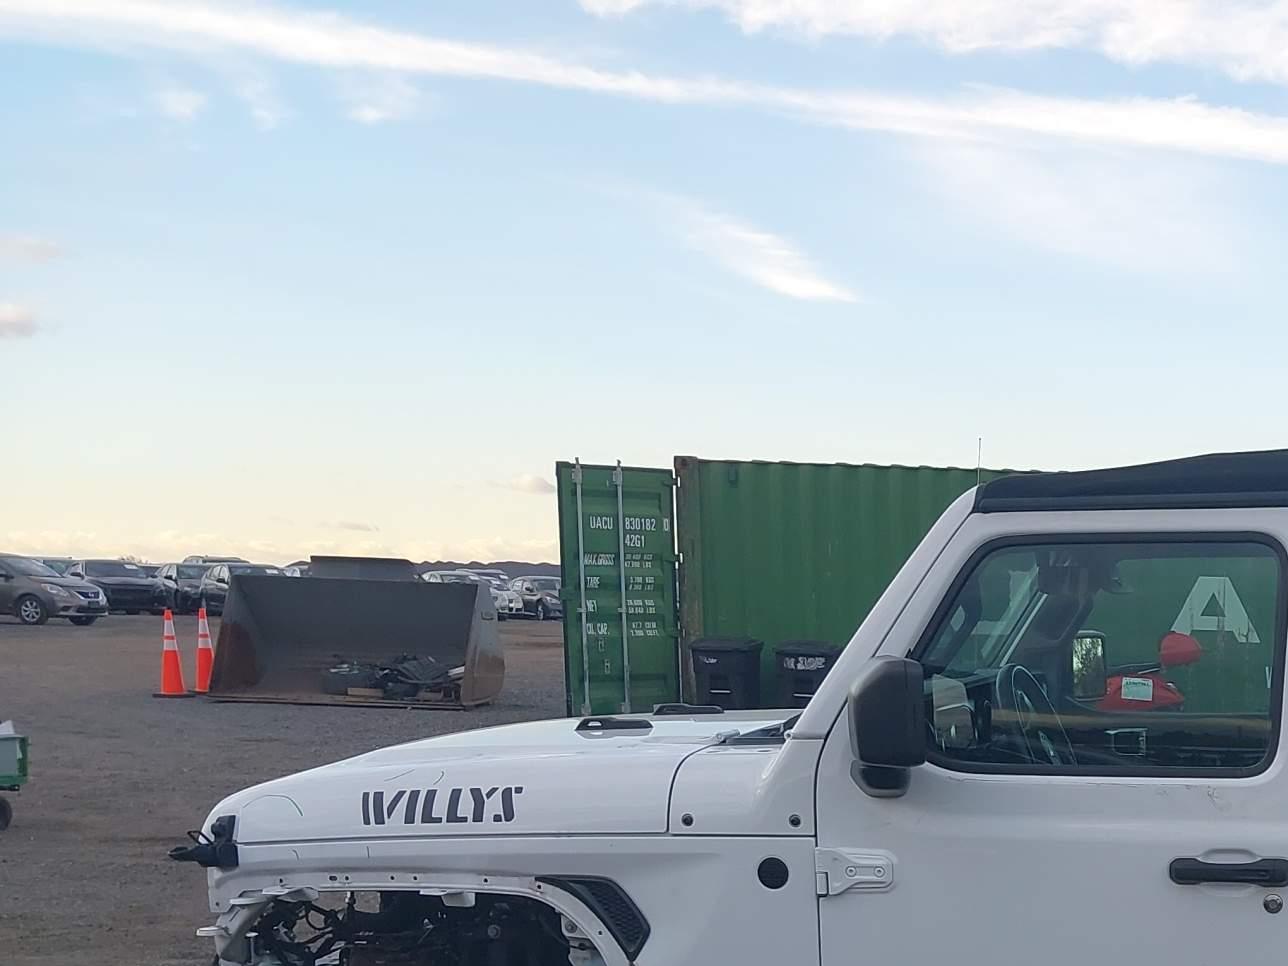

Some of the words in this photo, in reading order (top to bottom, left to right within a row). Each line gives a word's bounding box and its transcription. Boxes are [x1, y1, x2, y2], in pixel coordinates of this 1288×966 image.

[589, 516, 613, 530] UACU
[624, 517, 657, 531] 830182
[624, 534, 645, 548] 42G1
[1171, 576, 1261, 643] A
[362, 786, 524, 826] WILLYS
